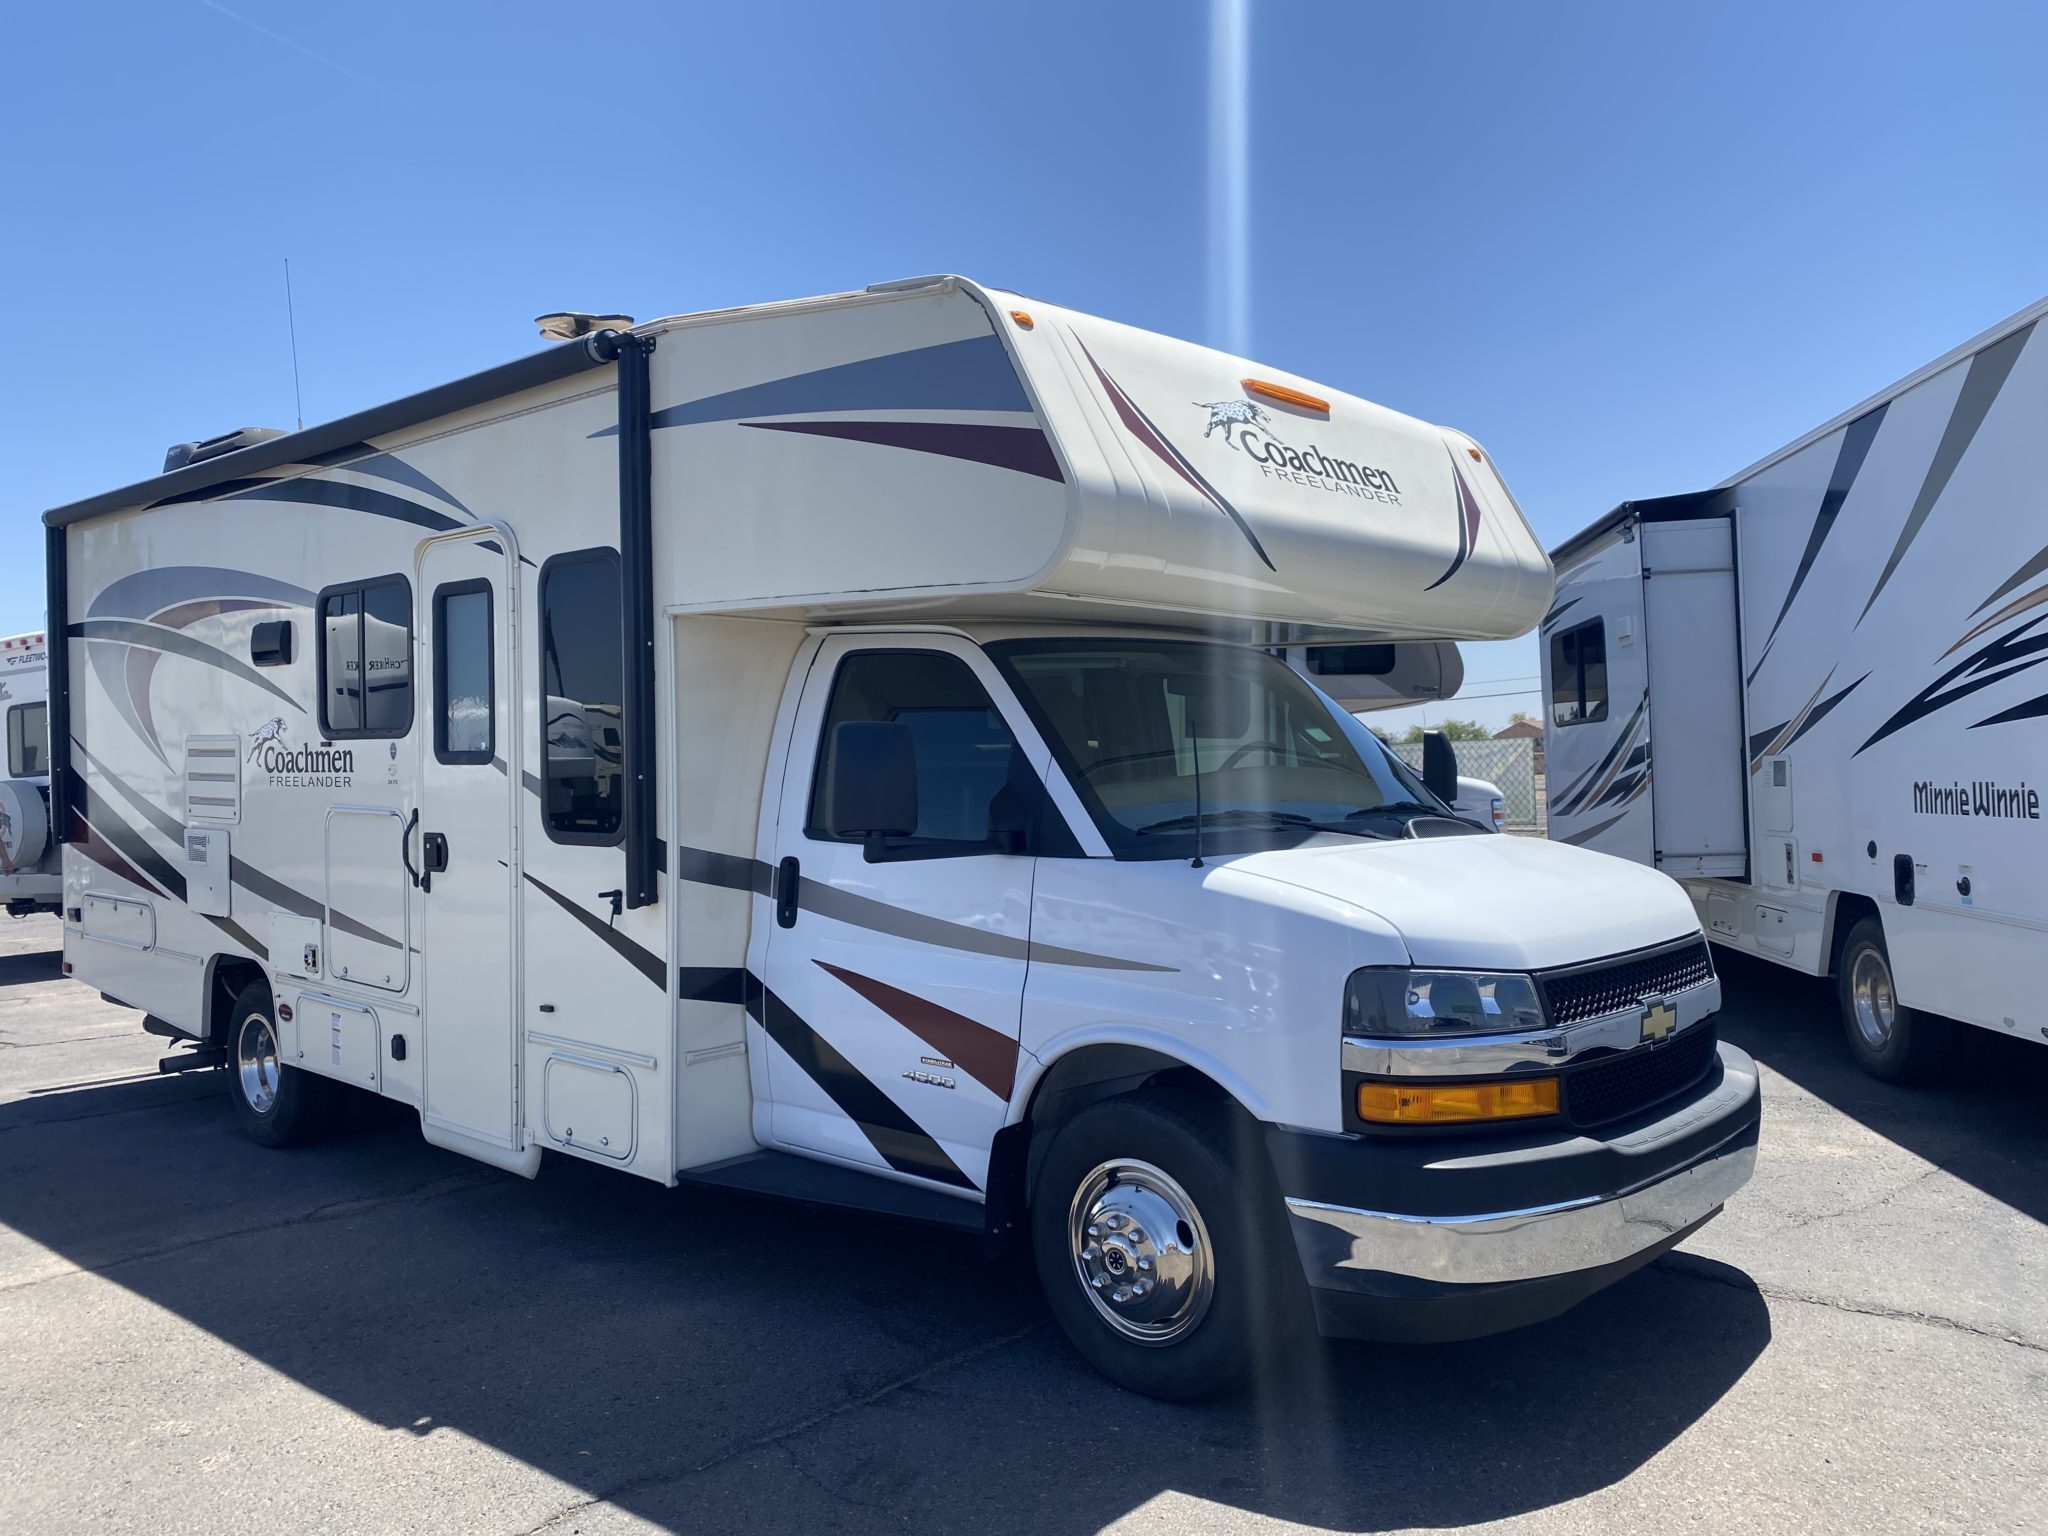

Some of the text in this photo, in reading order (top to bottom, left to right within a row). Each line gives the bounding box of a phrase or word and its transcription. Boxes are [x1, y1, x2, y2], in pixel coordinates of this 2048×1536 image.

[1239, 430, 1402, 494] Coachmen
[1260, 465, 1402, 506] FREELANDER
[264, 741, 354, 773] Coachmen
[269, 776, 352, 787] FREELANDER
[1913, 781, 2040, 819] Minnie Winnie
[902, 1070, 956, 1090] 4500
